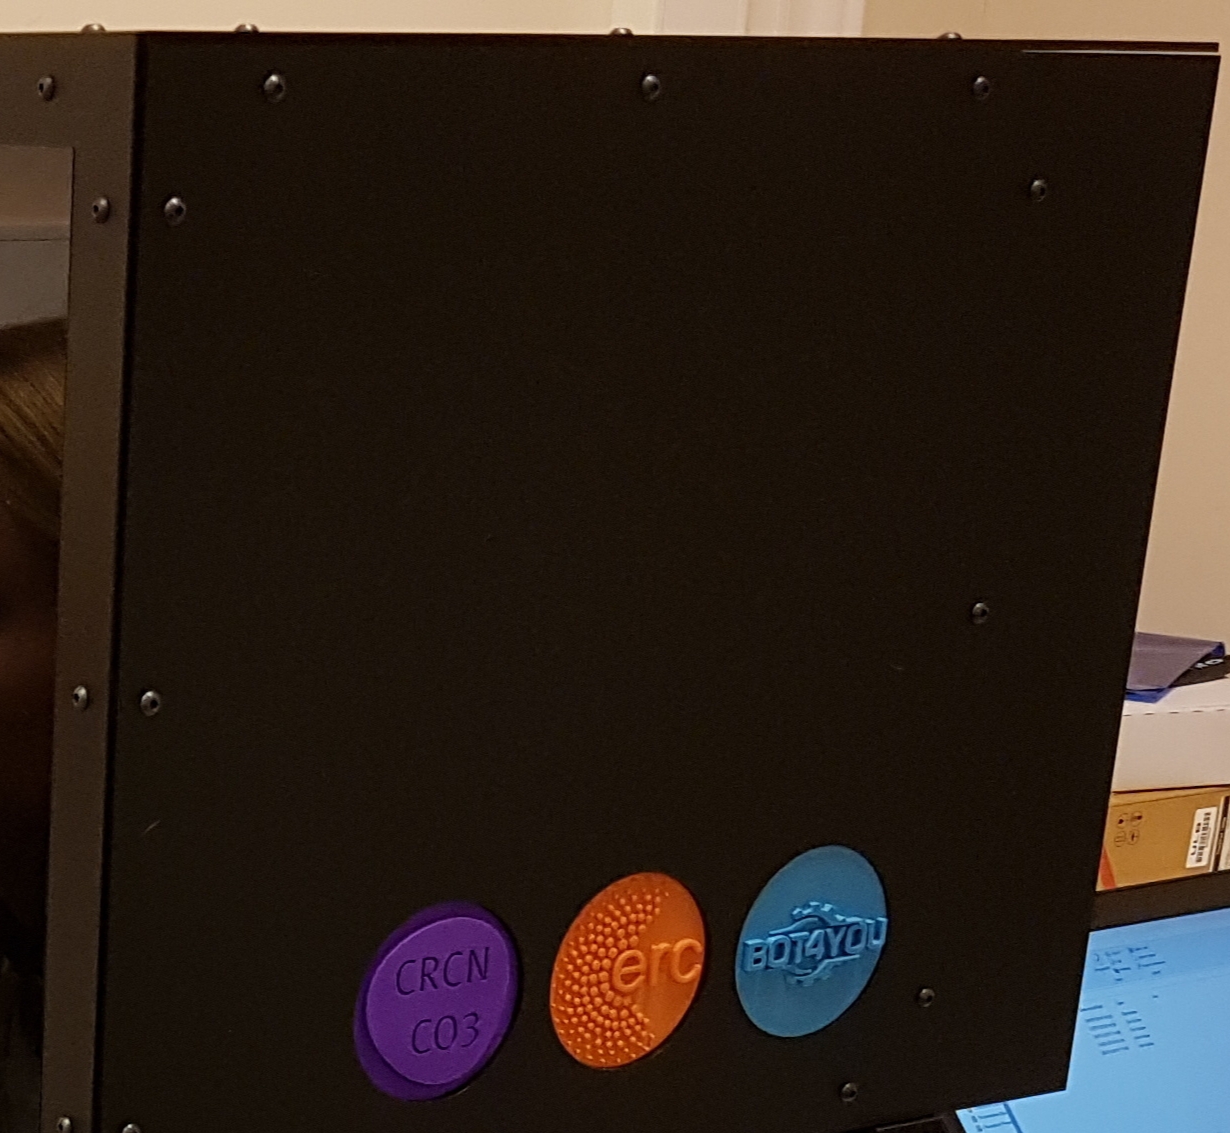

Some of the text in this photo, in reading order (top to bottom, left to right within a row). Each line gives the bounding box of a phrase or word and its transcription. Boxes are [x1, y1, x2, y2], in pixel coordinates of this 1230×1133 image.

[396, 946, 490, 996] CRCN
[612, 938, 703, 993] erc
[743, 917, 888, 972] BOT4YOU
